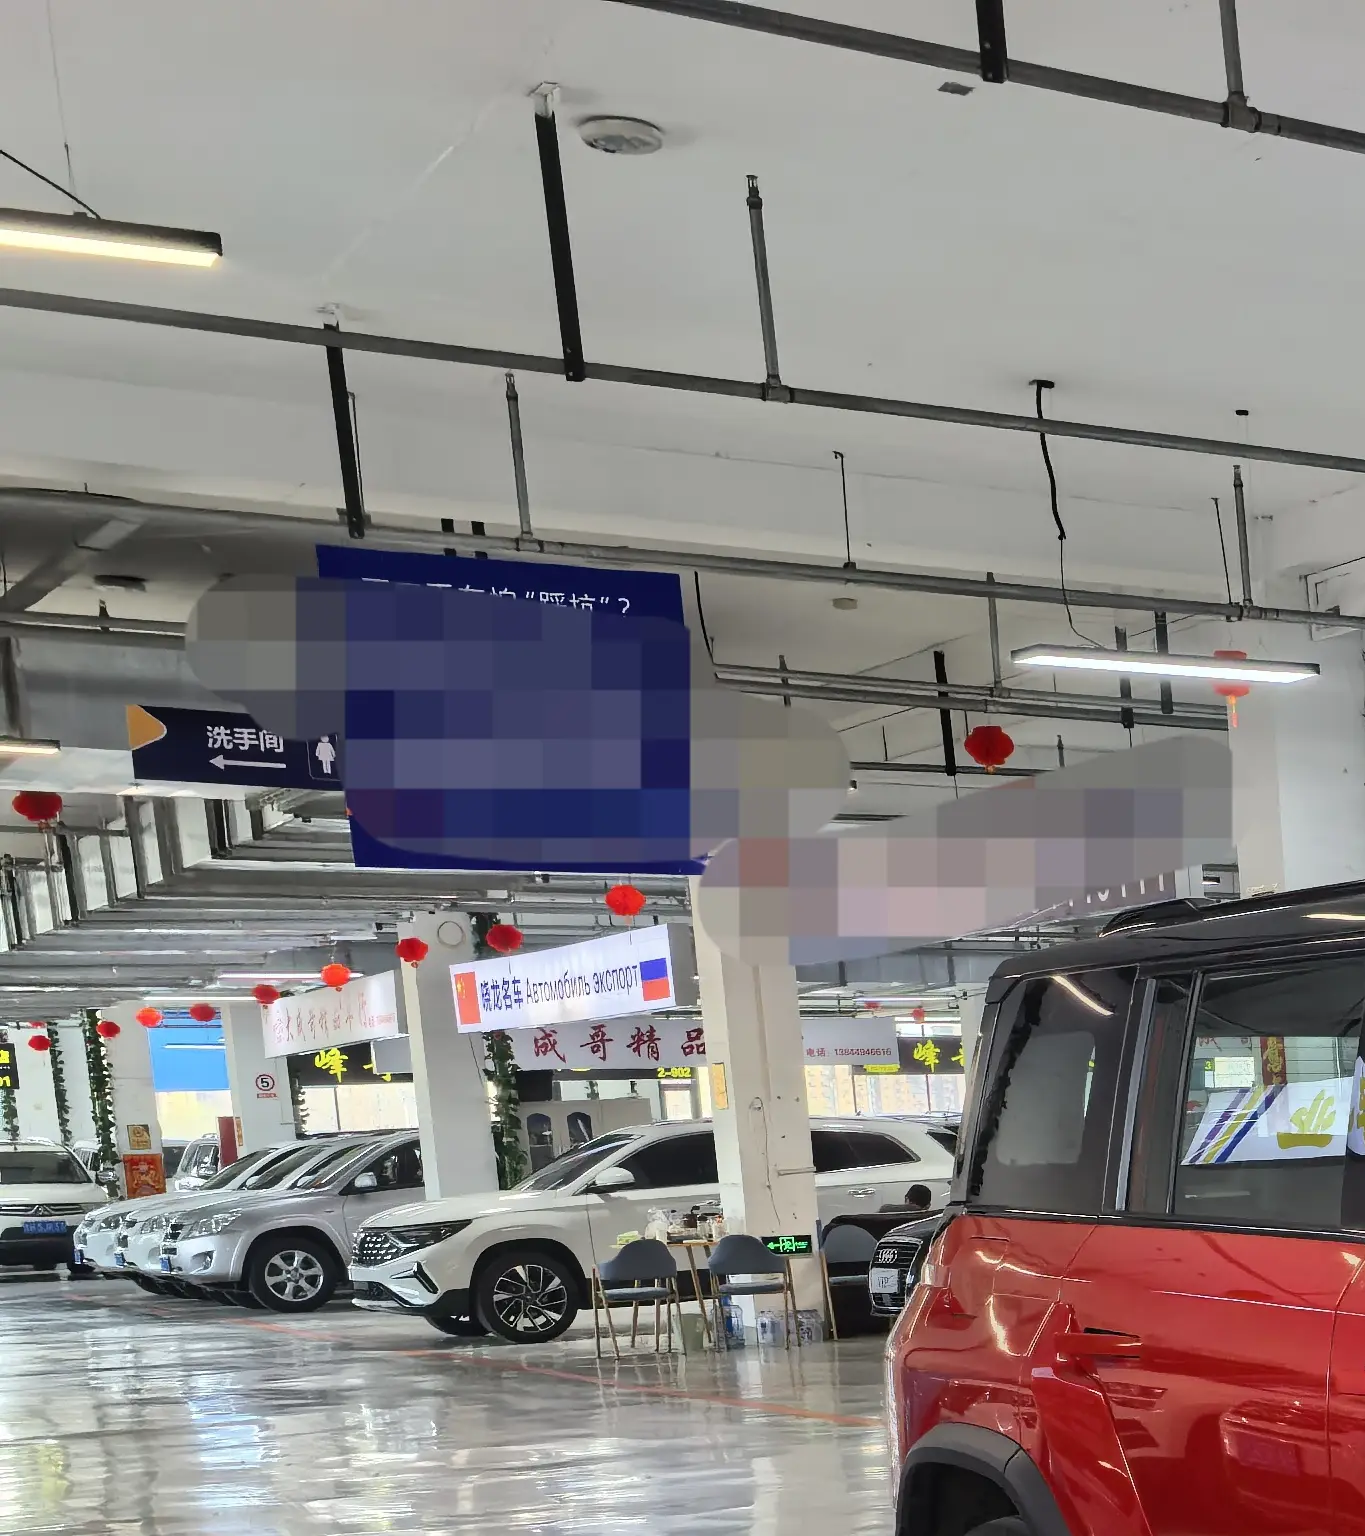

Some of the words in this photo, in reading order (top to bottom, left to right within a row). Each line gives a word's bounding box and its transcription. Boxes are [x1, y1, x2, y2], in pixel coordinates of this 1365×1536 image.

[206, 725, 284, 753] 洗手间
[526, 969, 591, 1004] Автомобиль
[592, 964, 638, 996] экспорт
[533, 1023, 706, 1064] 成哥精品
